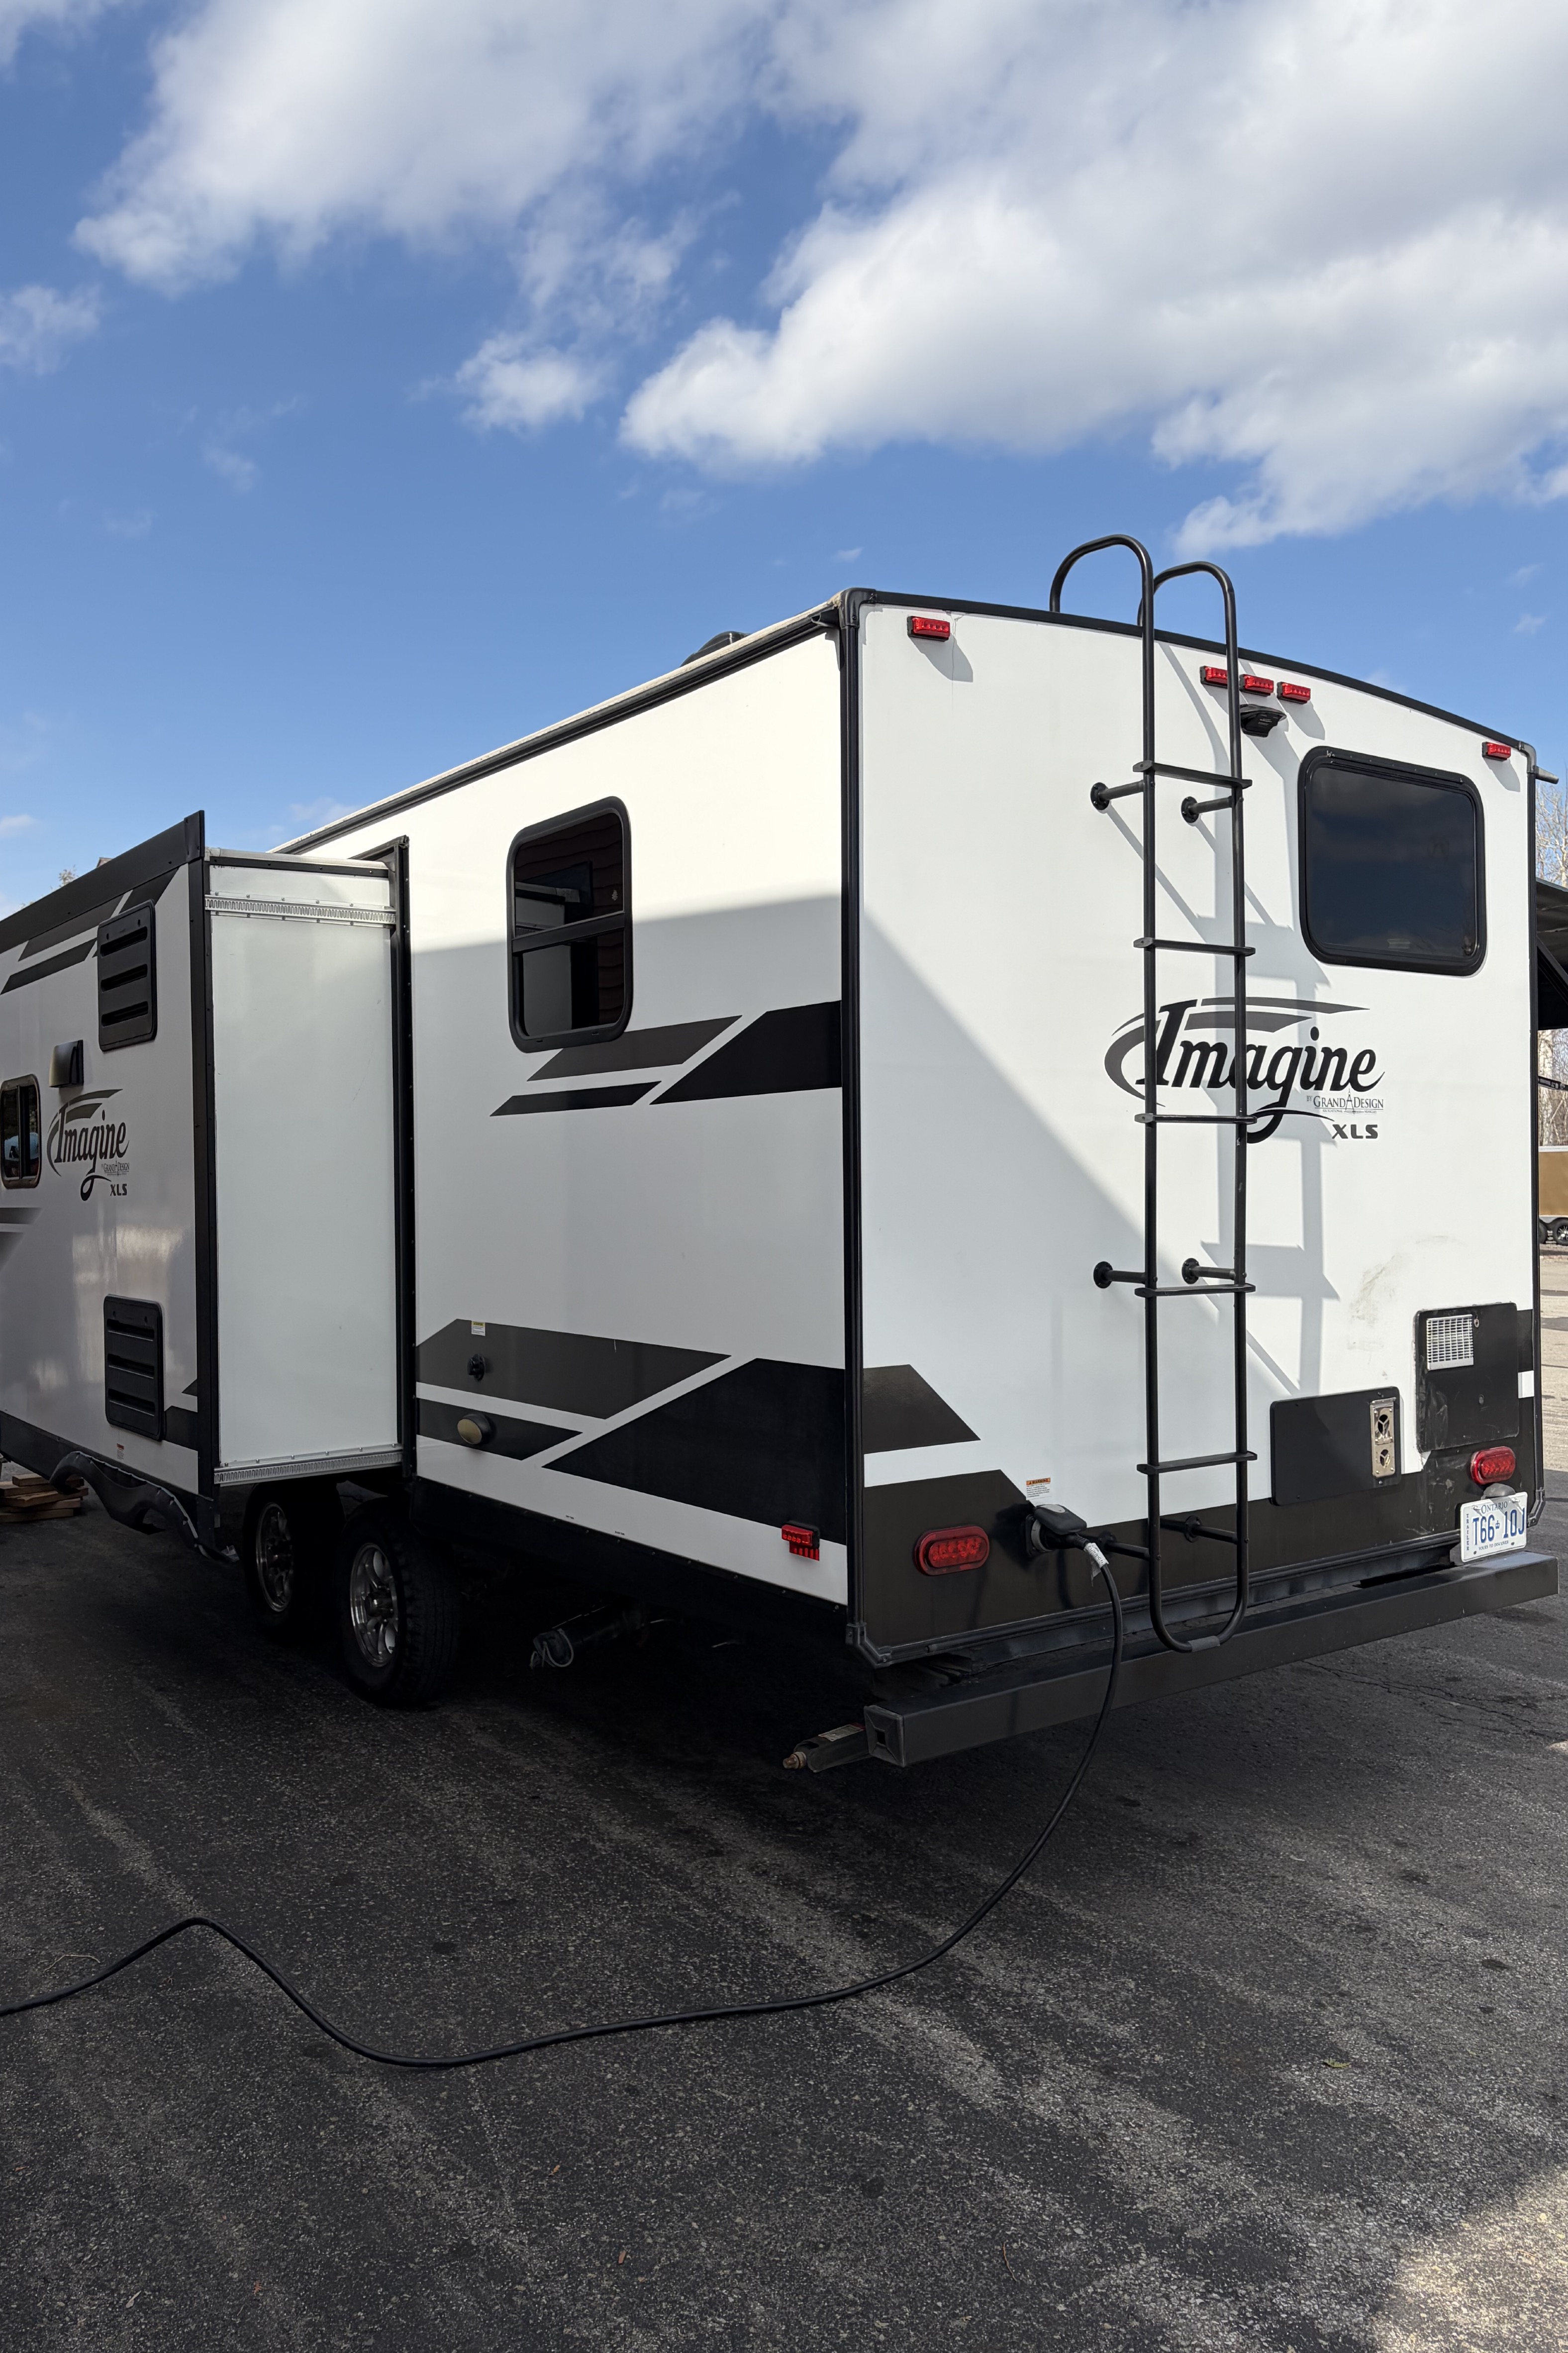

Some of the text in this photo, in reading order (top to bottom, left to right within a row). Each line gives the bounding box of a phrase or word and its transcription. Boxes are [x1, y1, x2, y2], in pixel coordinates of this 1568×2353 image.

[1135, 999, 1385, 1143] Imagine
[1313, 1096, 1346, 1107] GRAND
[1354, 1097, 1383, 1109] DESIGN
[1332, 1124, 1378, 1139] XLS
[54, 1102, 129, 1201] Imagine
[110, 1184, 127, 1196] XLS
[1481, 1502, 1507, 1514] ONTARIO
